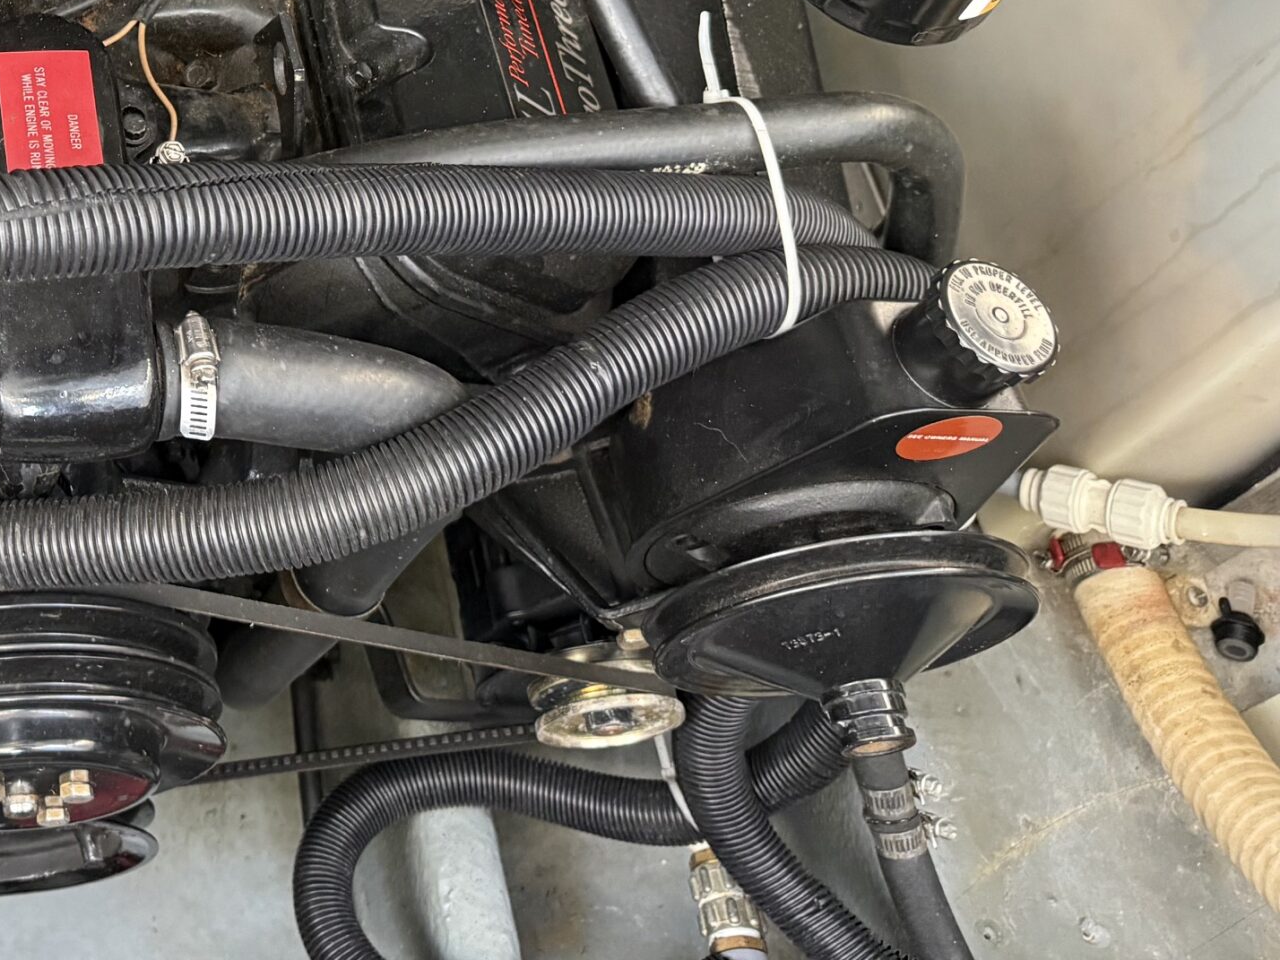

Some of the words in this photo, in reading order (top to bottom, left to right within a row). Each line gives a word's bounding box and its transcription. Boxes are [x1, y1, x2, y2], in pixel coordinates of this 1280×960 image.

[21, 73, 35, 102] WHILE
[34, 67, 46, 87] STAY
[25, 104, 38, 138] ENGINE
[36, 91, 50, 117] CLEAR
[41, 120, 52, 131] OF
[67, 114, 83, 150] DANGER
[29, 140, 40, 149] IS
[43, 134, 57, 170] MOVING
[972, 265, 1012, 283] PROPER
[1016, 281, 1042, 311] LEVEL
[988, 281, 1034, 319] OVERFILL
[960, 320, 977, 339] USE
[980, 340, 1035, 366] APPROVED
